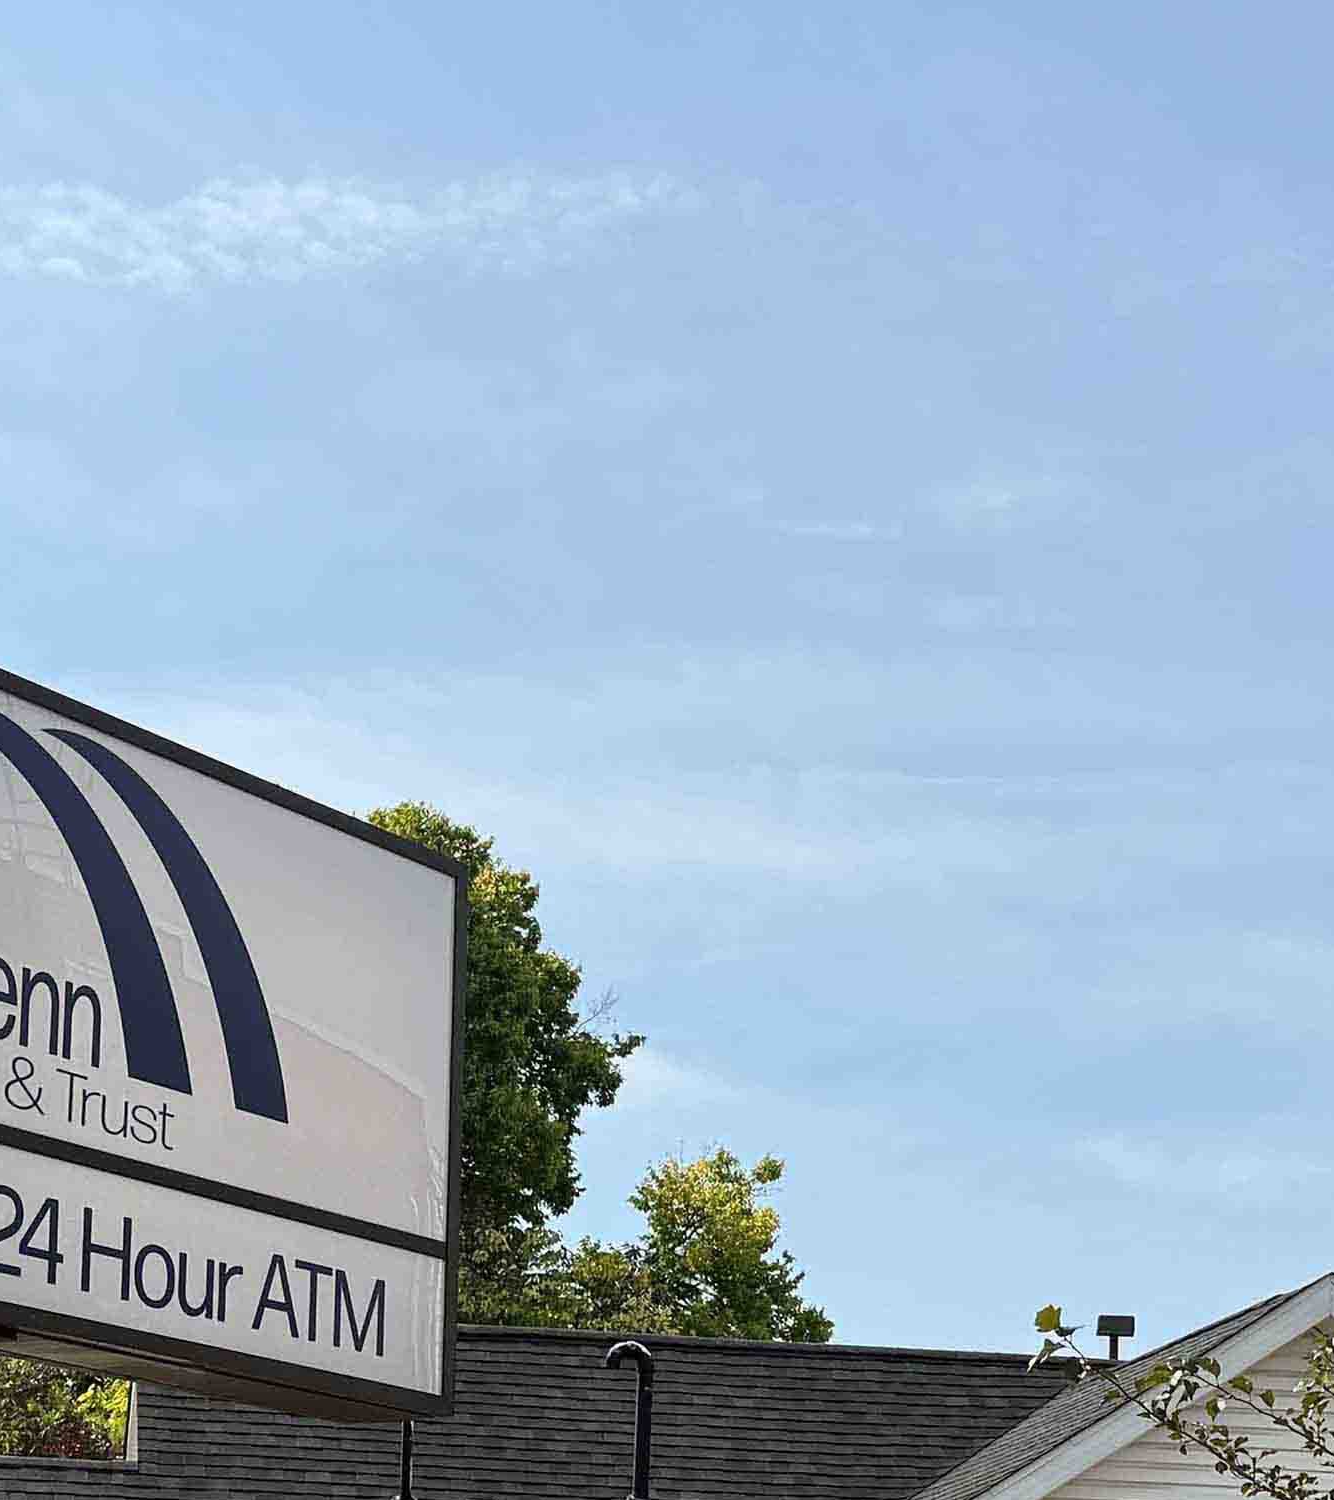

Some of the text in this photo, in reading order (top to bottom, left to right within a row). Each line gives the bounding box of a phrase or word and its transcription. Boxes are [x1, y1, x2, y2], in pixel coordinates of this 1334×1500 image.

[4, 1056, 45, 1116] &
[55, 1067, 176, 1151] Trust
[80, 1207, 244, 1323] Hour
[250, 1252, 386, 1358] ATM
